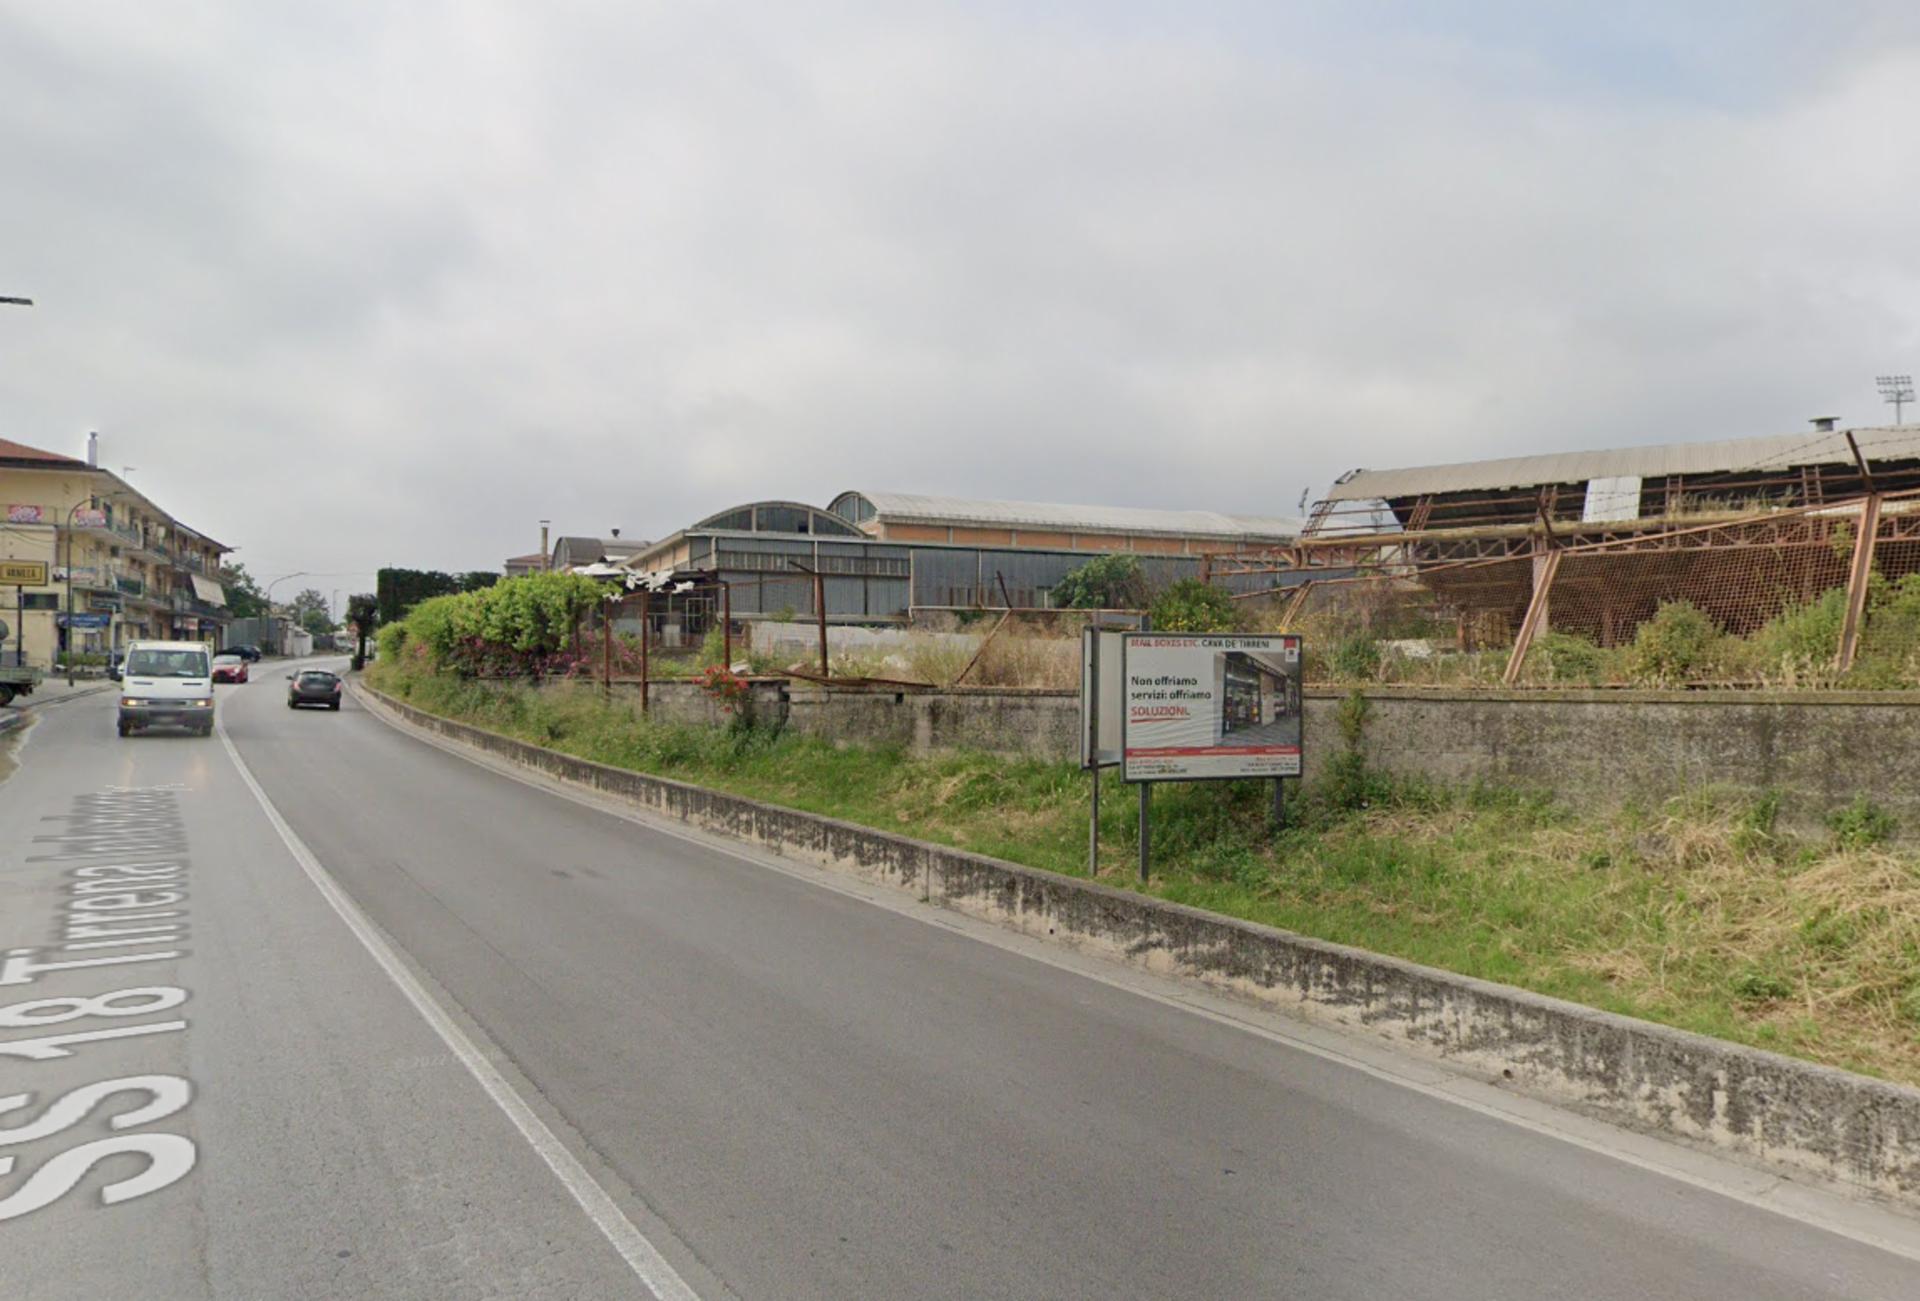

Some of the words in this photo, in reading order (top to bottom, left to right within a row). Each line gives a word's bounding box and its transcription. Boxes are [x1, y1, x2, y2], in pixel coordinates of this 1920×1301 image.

[1201, 639, 1223, 648] CAVA
[1225, 639, 1237, 648] DE
[1131, 675, 1153, 686] Non
[1154, 675, 1198, 686] offriamo
[1131, 690, 1167, 700] servizi:
[1169, 689, 1212, 700] offriamo
